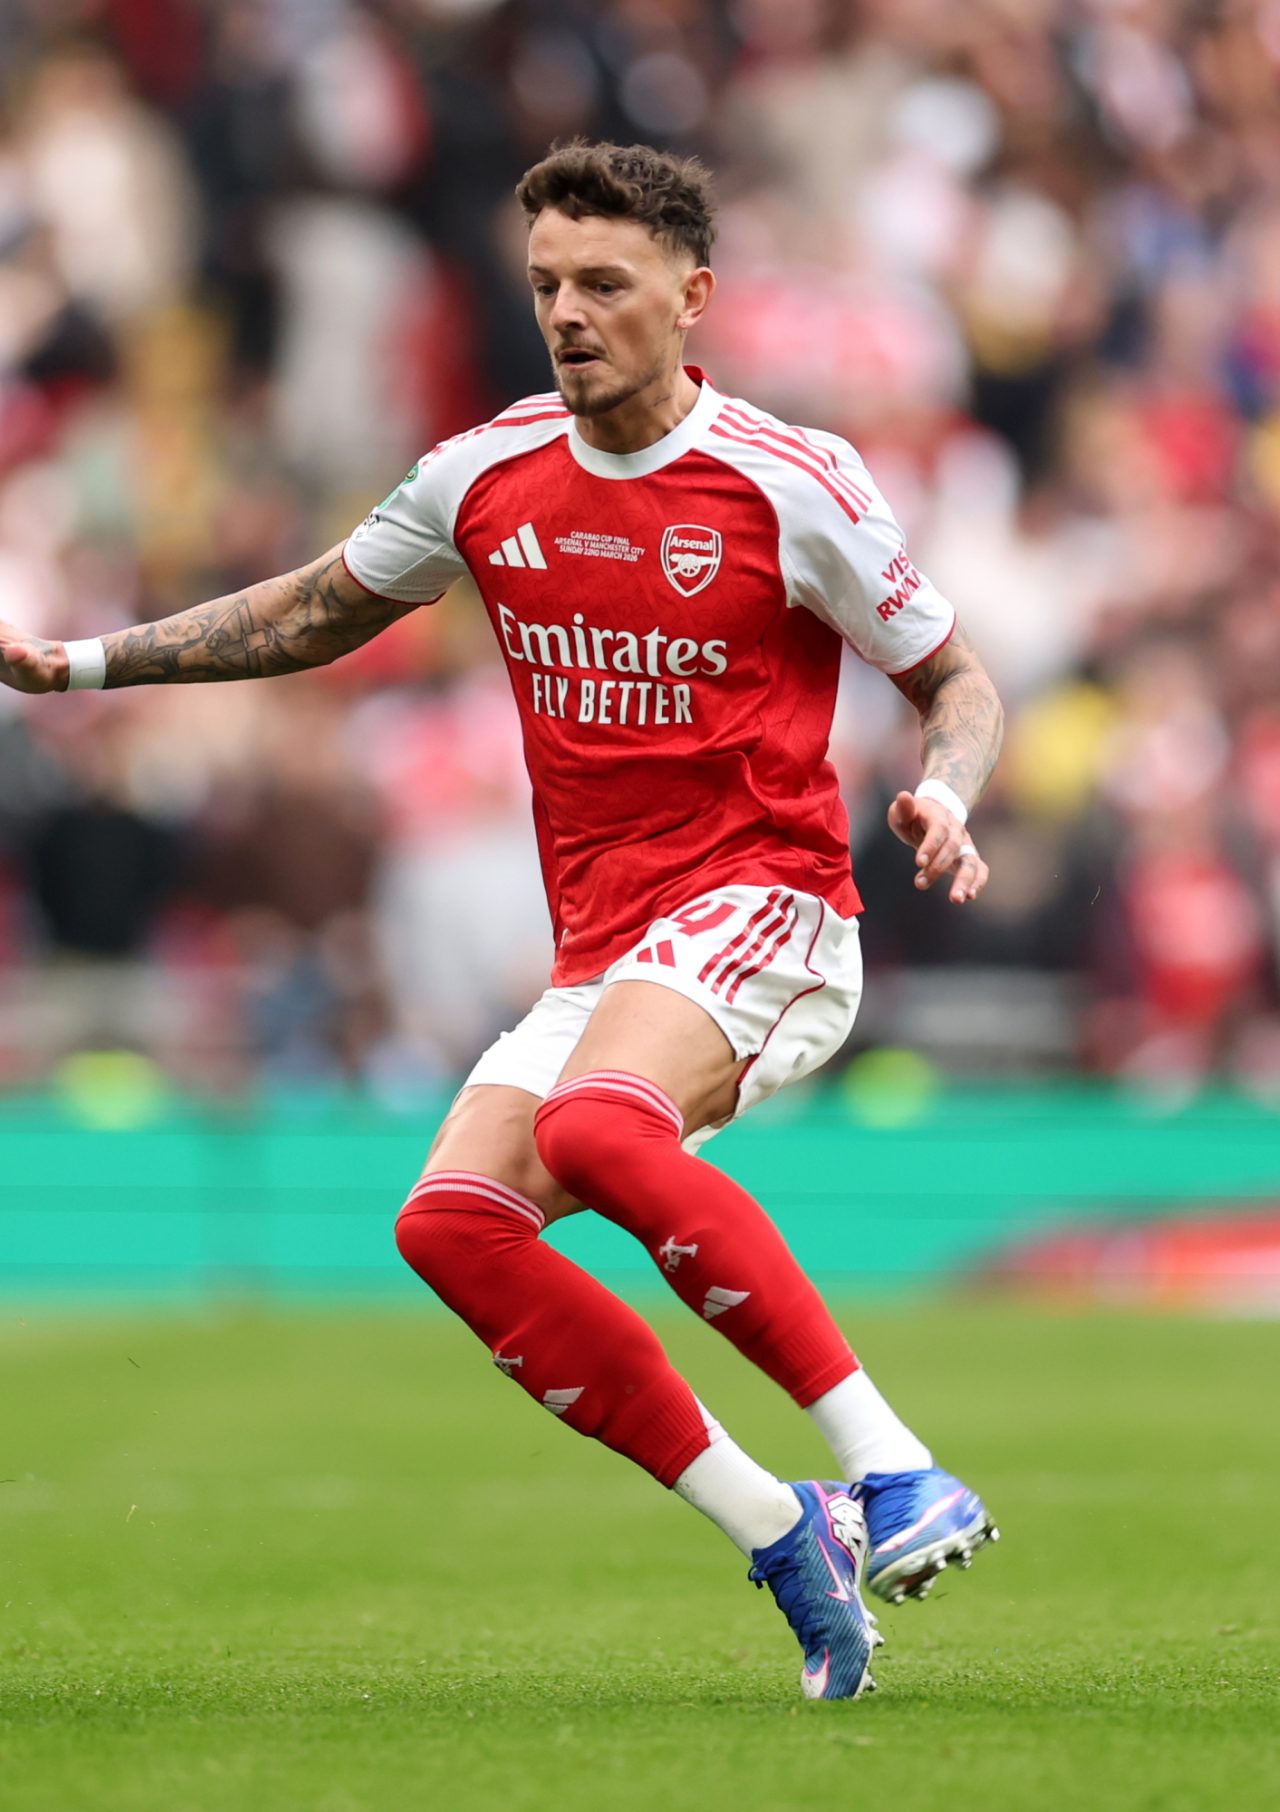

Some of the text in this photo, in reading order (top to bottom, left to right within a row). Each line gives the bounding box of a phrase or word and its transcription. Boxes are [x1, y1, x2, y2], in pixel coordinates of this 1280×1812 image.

[554, 537, 646, 556] ARSENAL V MANCHESTER CITY
[570, 530, 630, 545] CARABAO CUP FINAL
[670, 536, 713, 551] Arsenal
[559, 544, 584, 554] SUNDAY
[583, 548, 600, 557] 22ND
[600, 550, 623, 560] MARCH
[881, 546, 910, 583] VIS
[497, 602, 728, 677] Emirates
[532, 673, 693, 725] FLY BETTER
